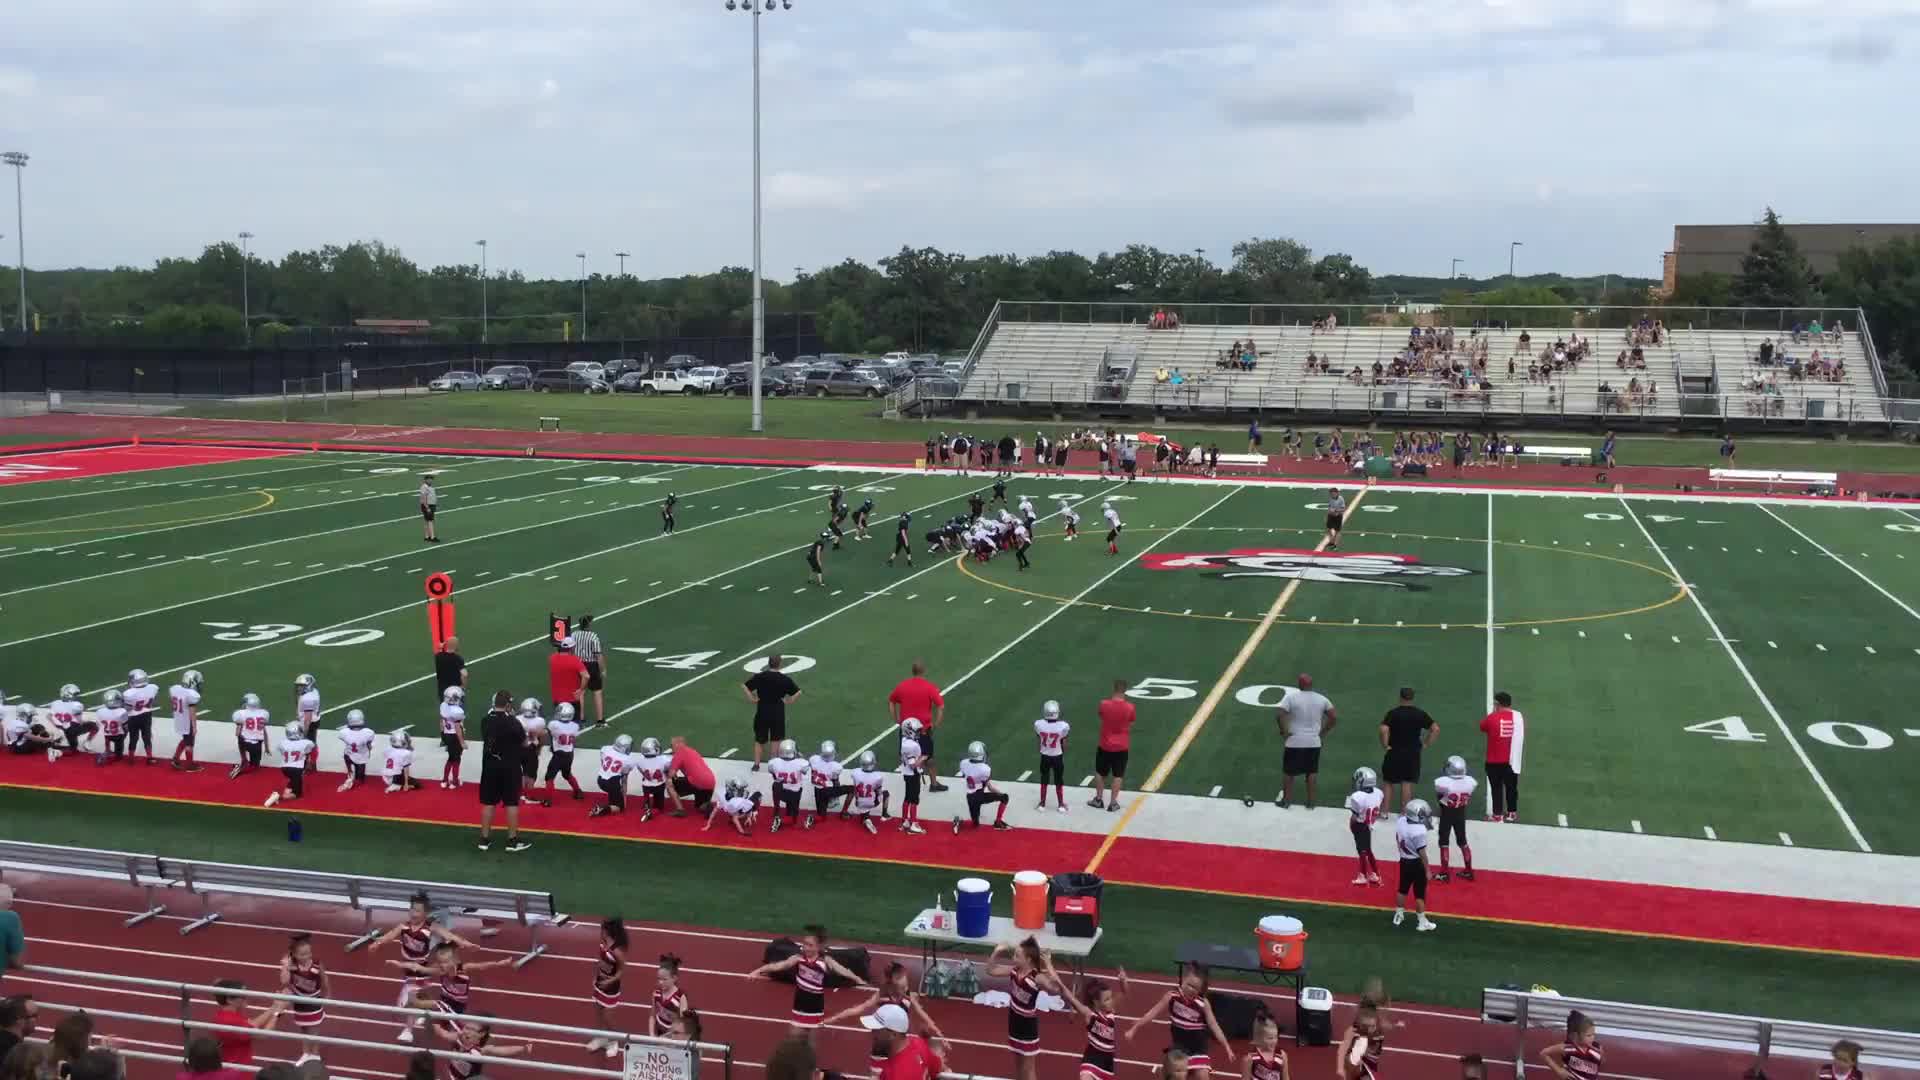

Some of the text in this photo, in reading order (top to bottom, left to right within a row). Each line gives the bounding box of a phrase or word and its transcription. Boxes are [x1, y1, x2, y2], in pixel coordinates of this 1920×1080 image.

[213, 623, 385, 647] 30
[554, 619, 567, 642] 3
[646, 650, 816, 676] 40
[1125, 677, 1301, 708] 50
[1040, 732, 1060, 748] 77
[1683, 716, 1894, 750] 40
[603, 755, 623, 774] 33
[1272, 943, 1283, 954] G
[648, 1051, 669, 1065] NO
[633, 1061, 682, 1075] STANDING
[638, 1071, 674, 1080] AISLES
